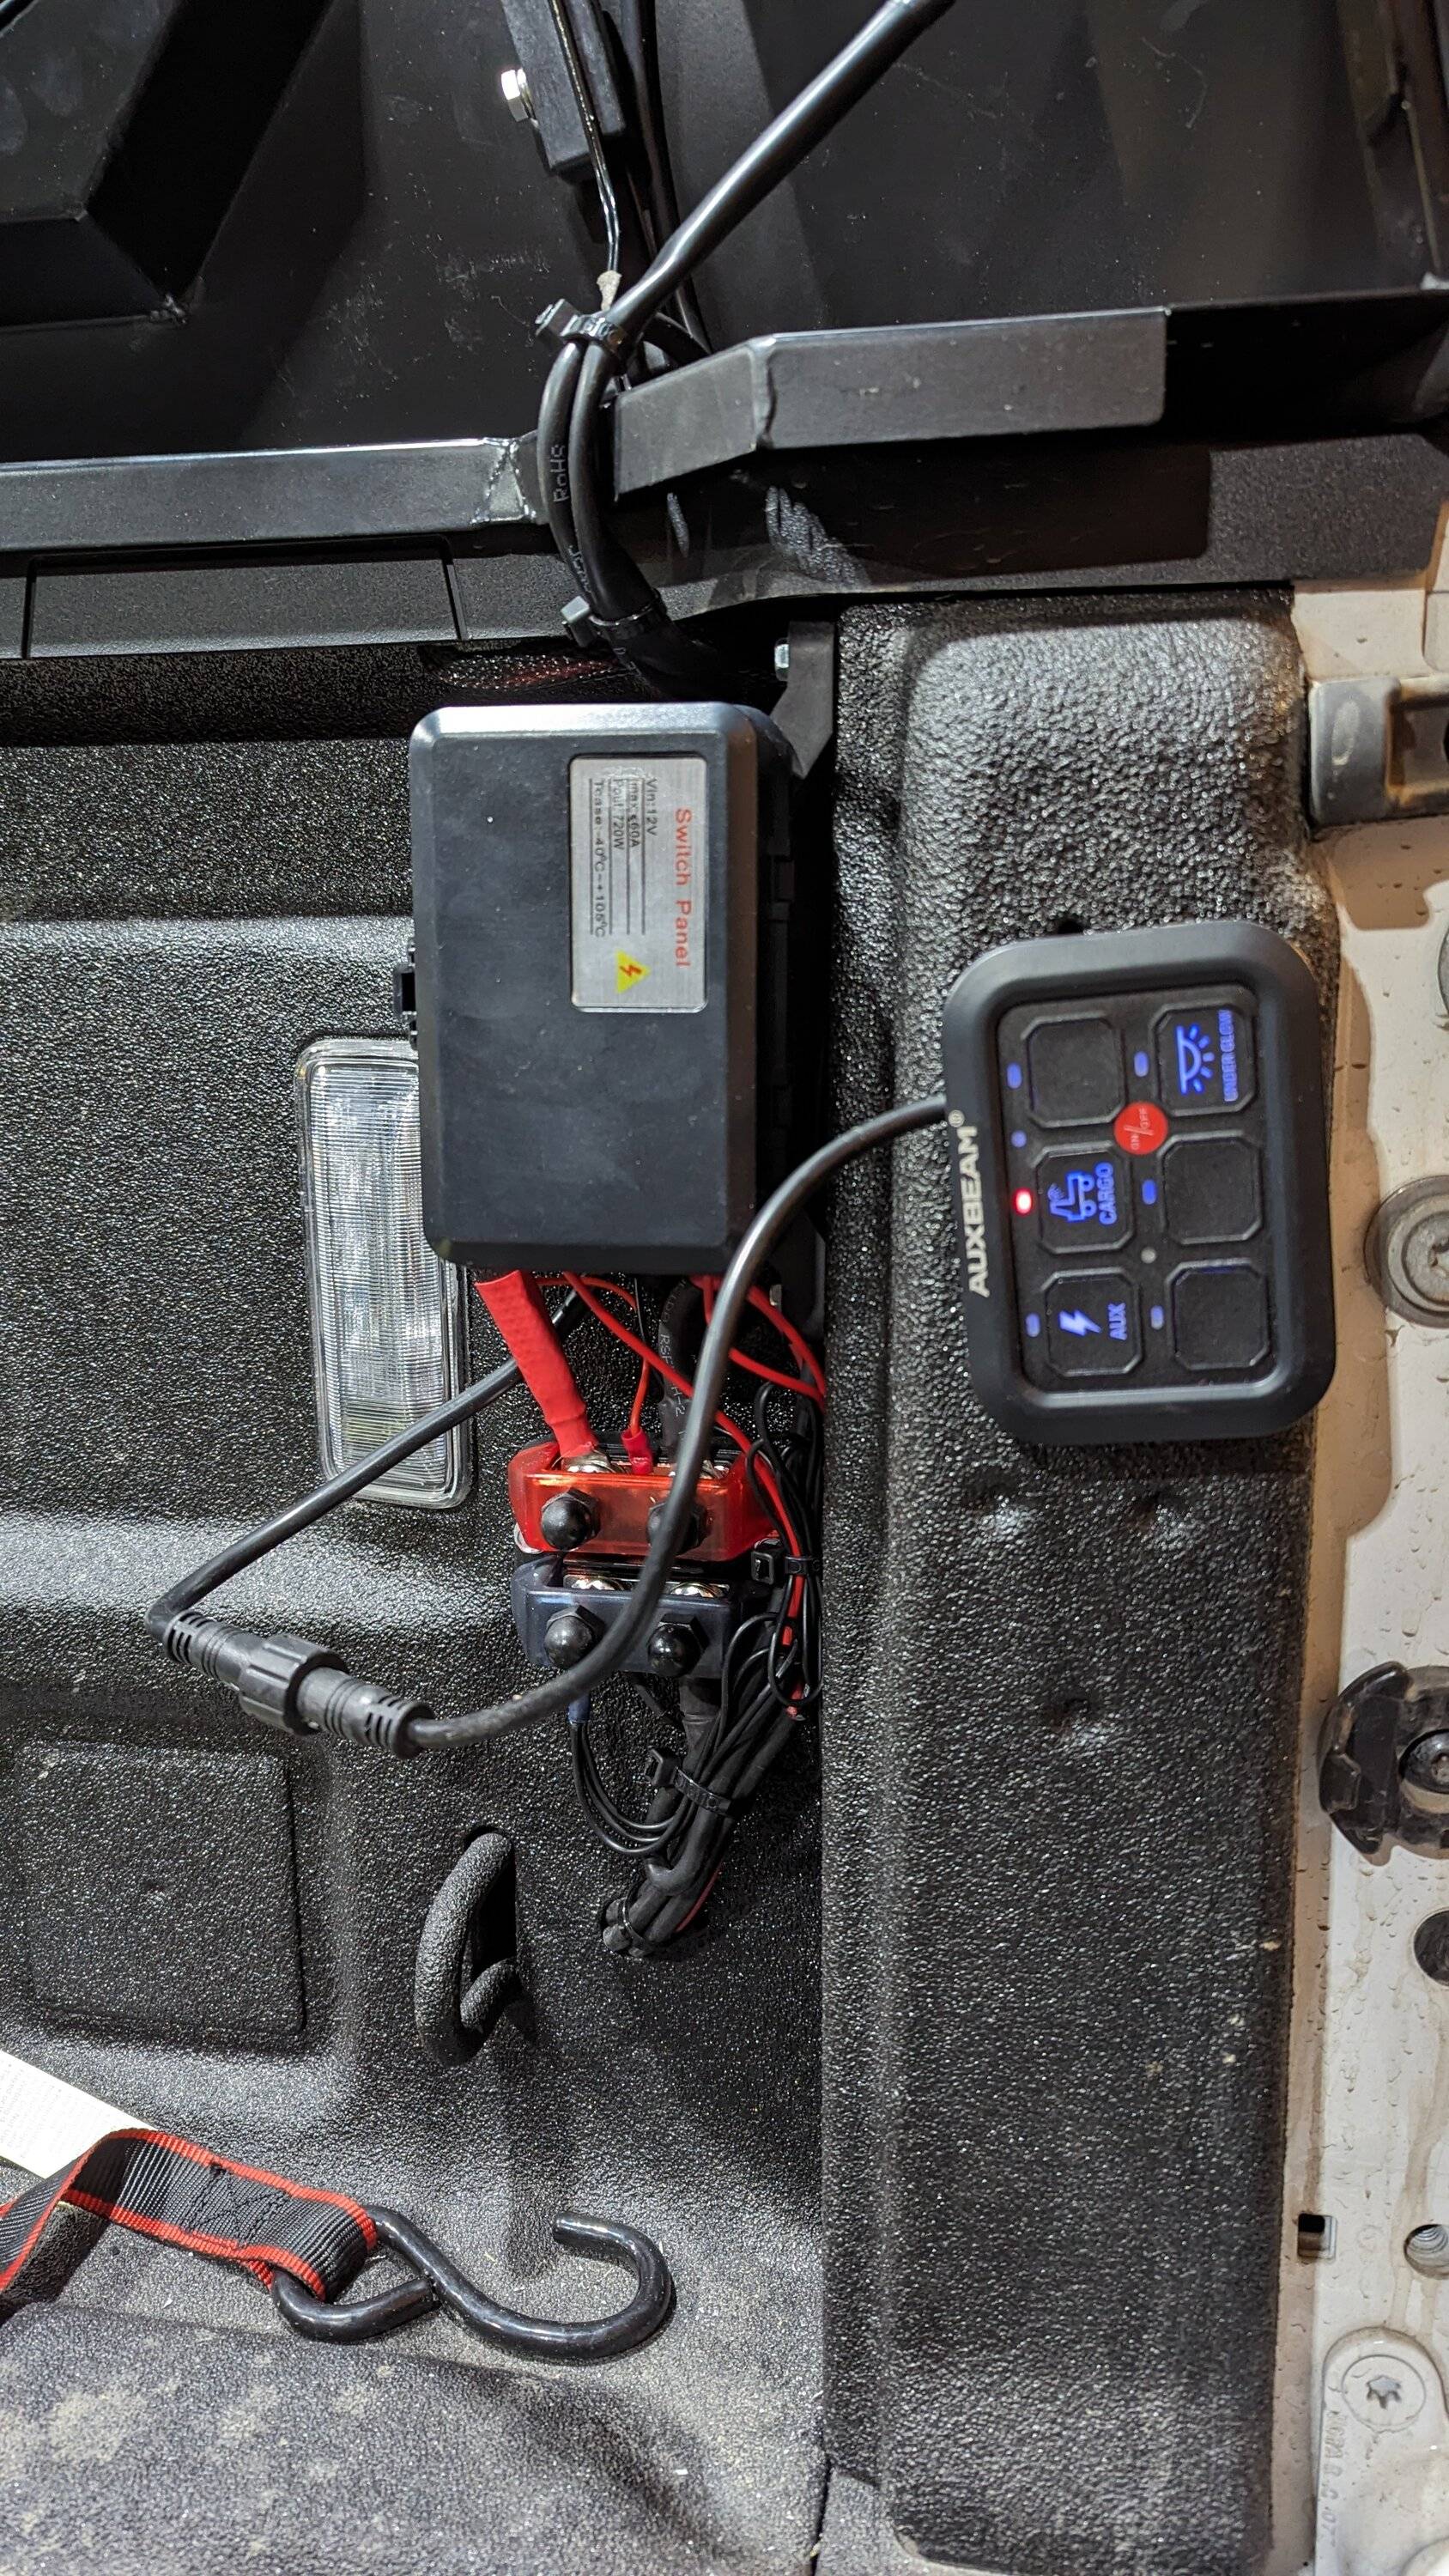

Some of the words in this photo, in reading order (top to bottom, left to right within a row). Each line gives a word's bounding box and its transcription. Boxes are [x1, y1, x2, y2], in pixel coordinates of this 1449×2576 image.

[550, 444, 570, 501] RoHS
[675, 808, 693, 886] Switch
[675, 900, 693, 967] Panel
[1218, 1009, 1236, 1052] GLOW
[1221, 1052, 1239, 1103] UNDER
[1095, 1162, 1118, 1225] CARGO
[1107, 1303, 1128, 1340] AUX
